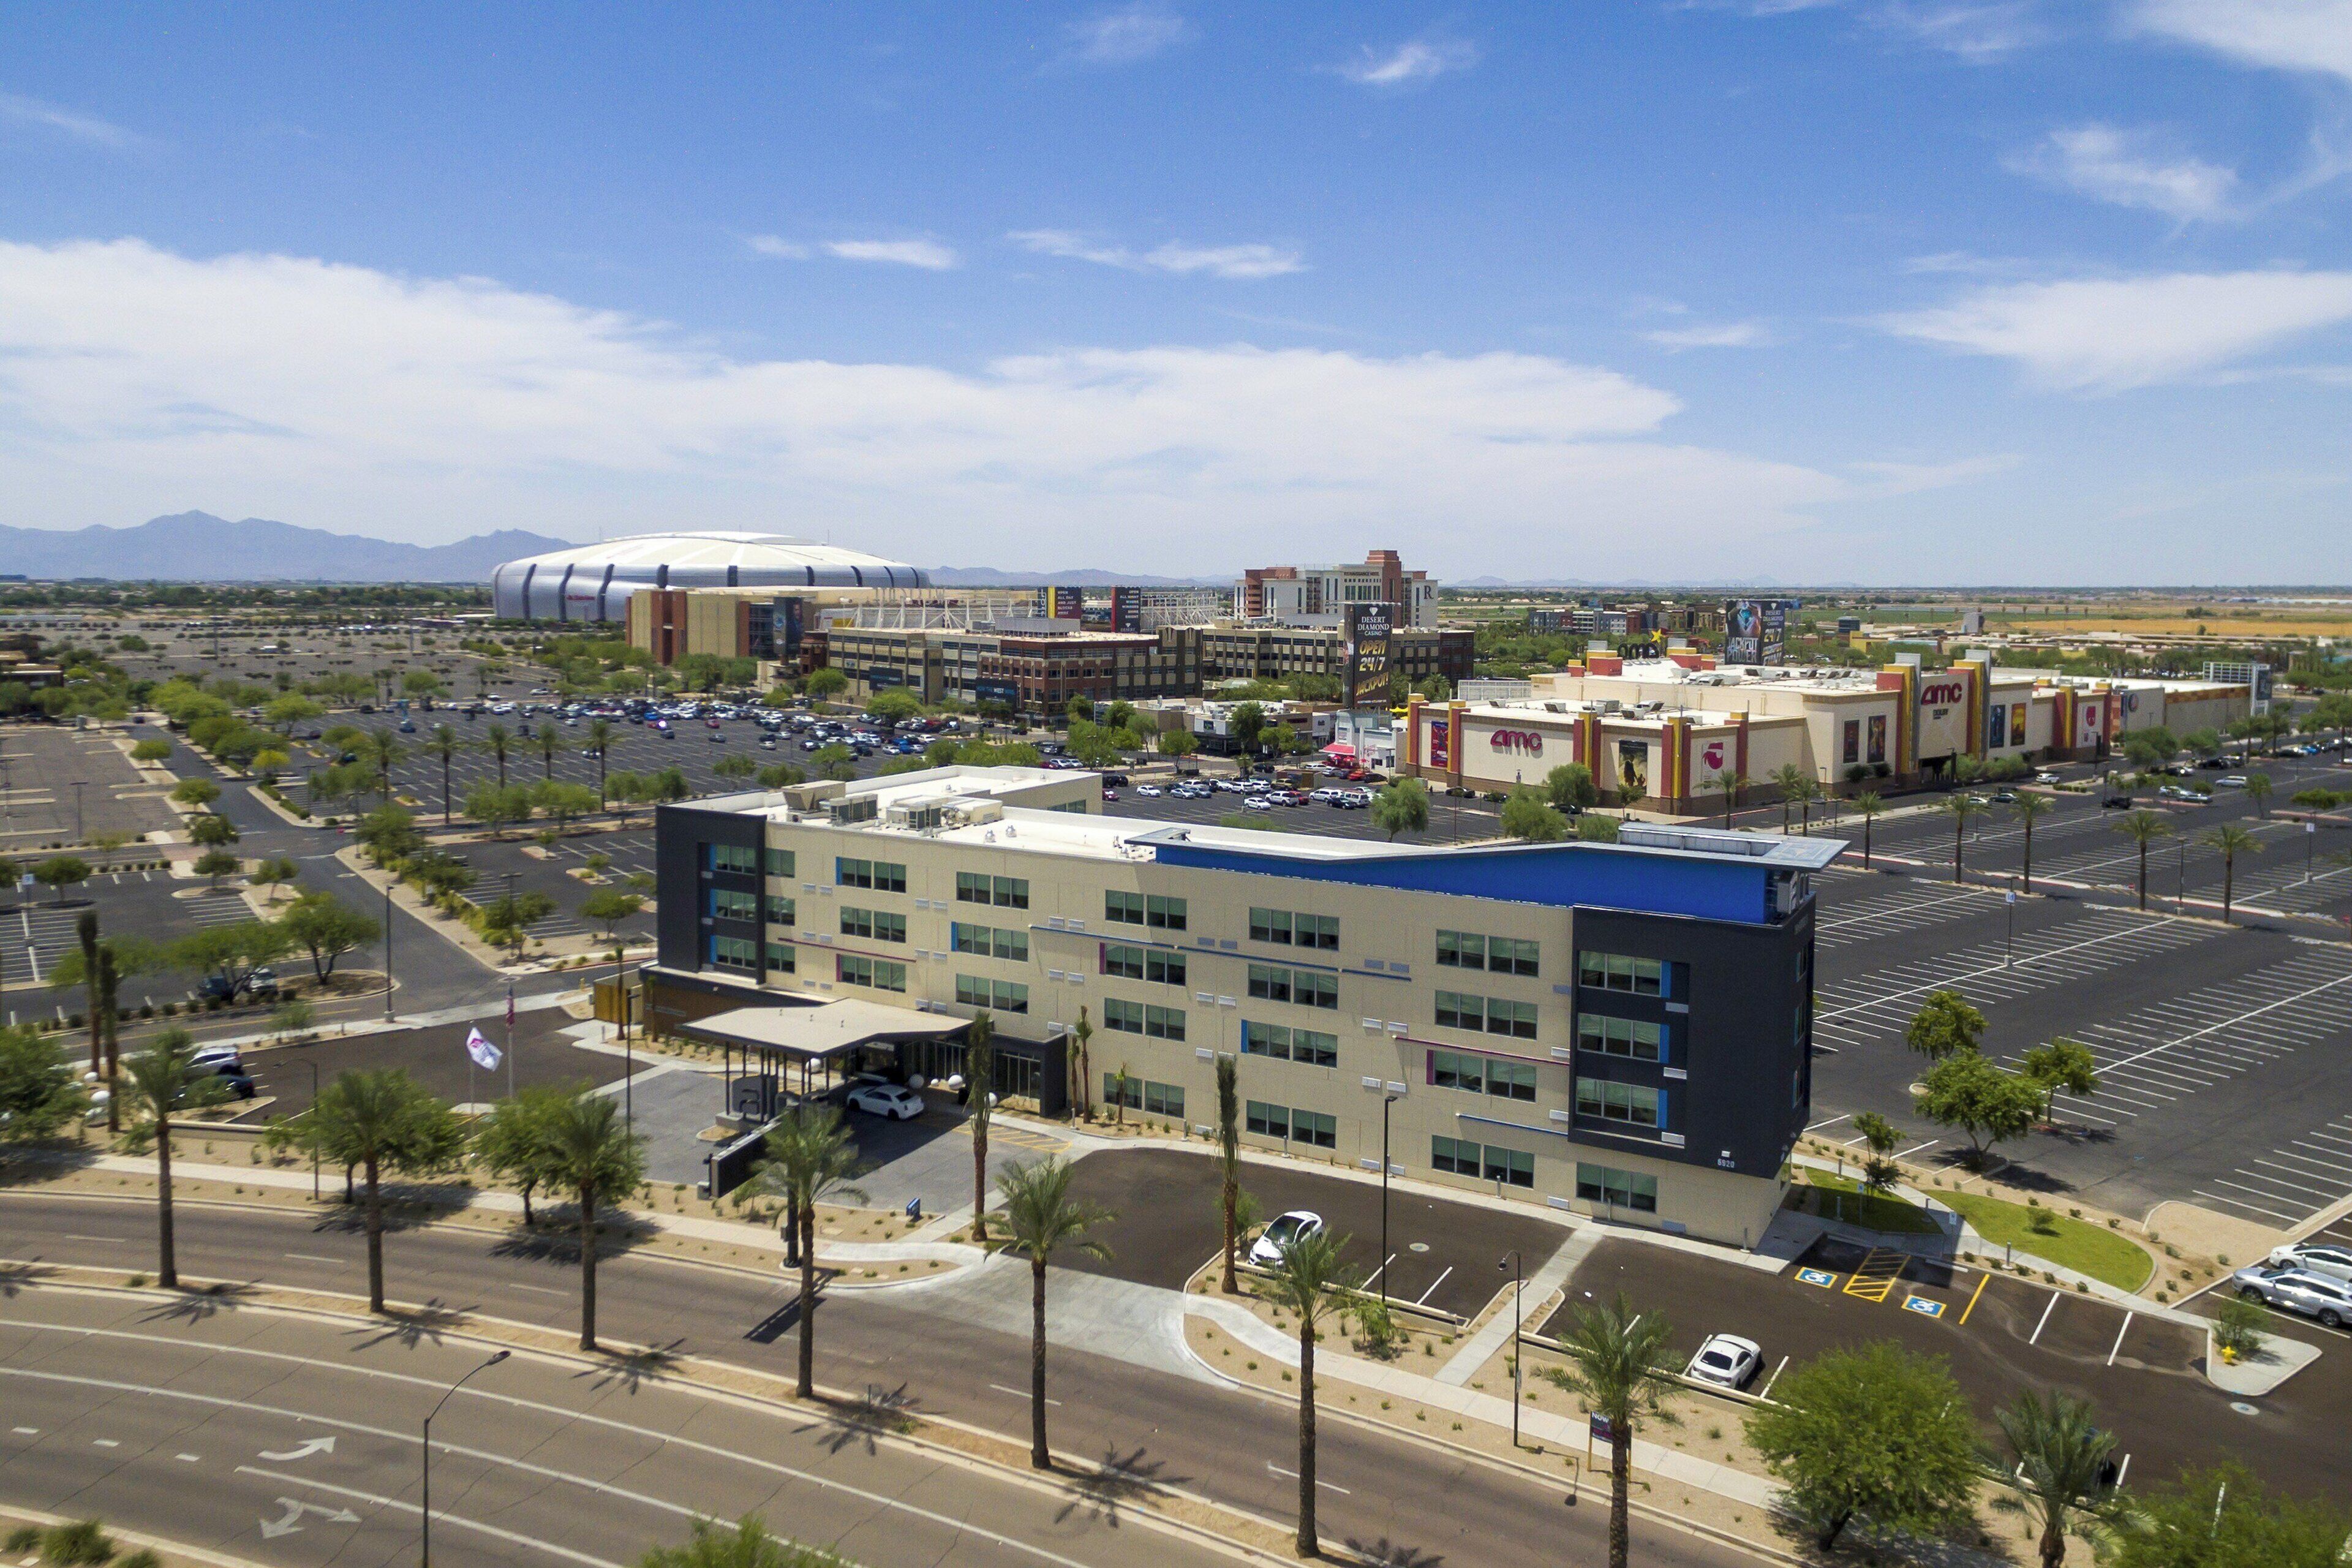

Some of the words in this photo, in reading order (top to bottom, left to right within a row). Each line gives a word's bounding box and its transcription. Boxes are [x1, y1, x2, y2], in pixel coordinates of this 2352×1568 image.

[1424, 586, 1434, 600] R
[1359, 640, 1387, 655] OPEN
[1727, 637, 1759, 650] JACKPOT
[1359, 657, 1385, 672] 24/7
[1355, 672, 1389, 696] JACKPOT!
[1717, 1158, 1735, 1168] 6920
